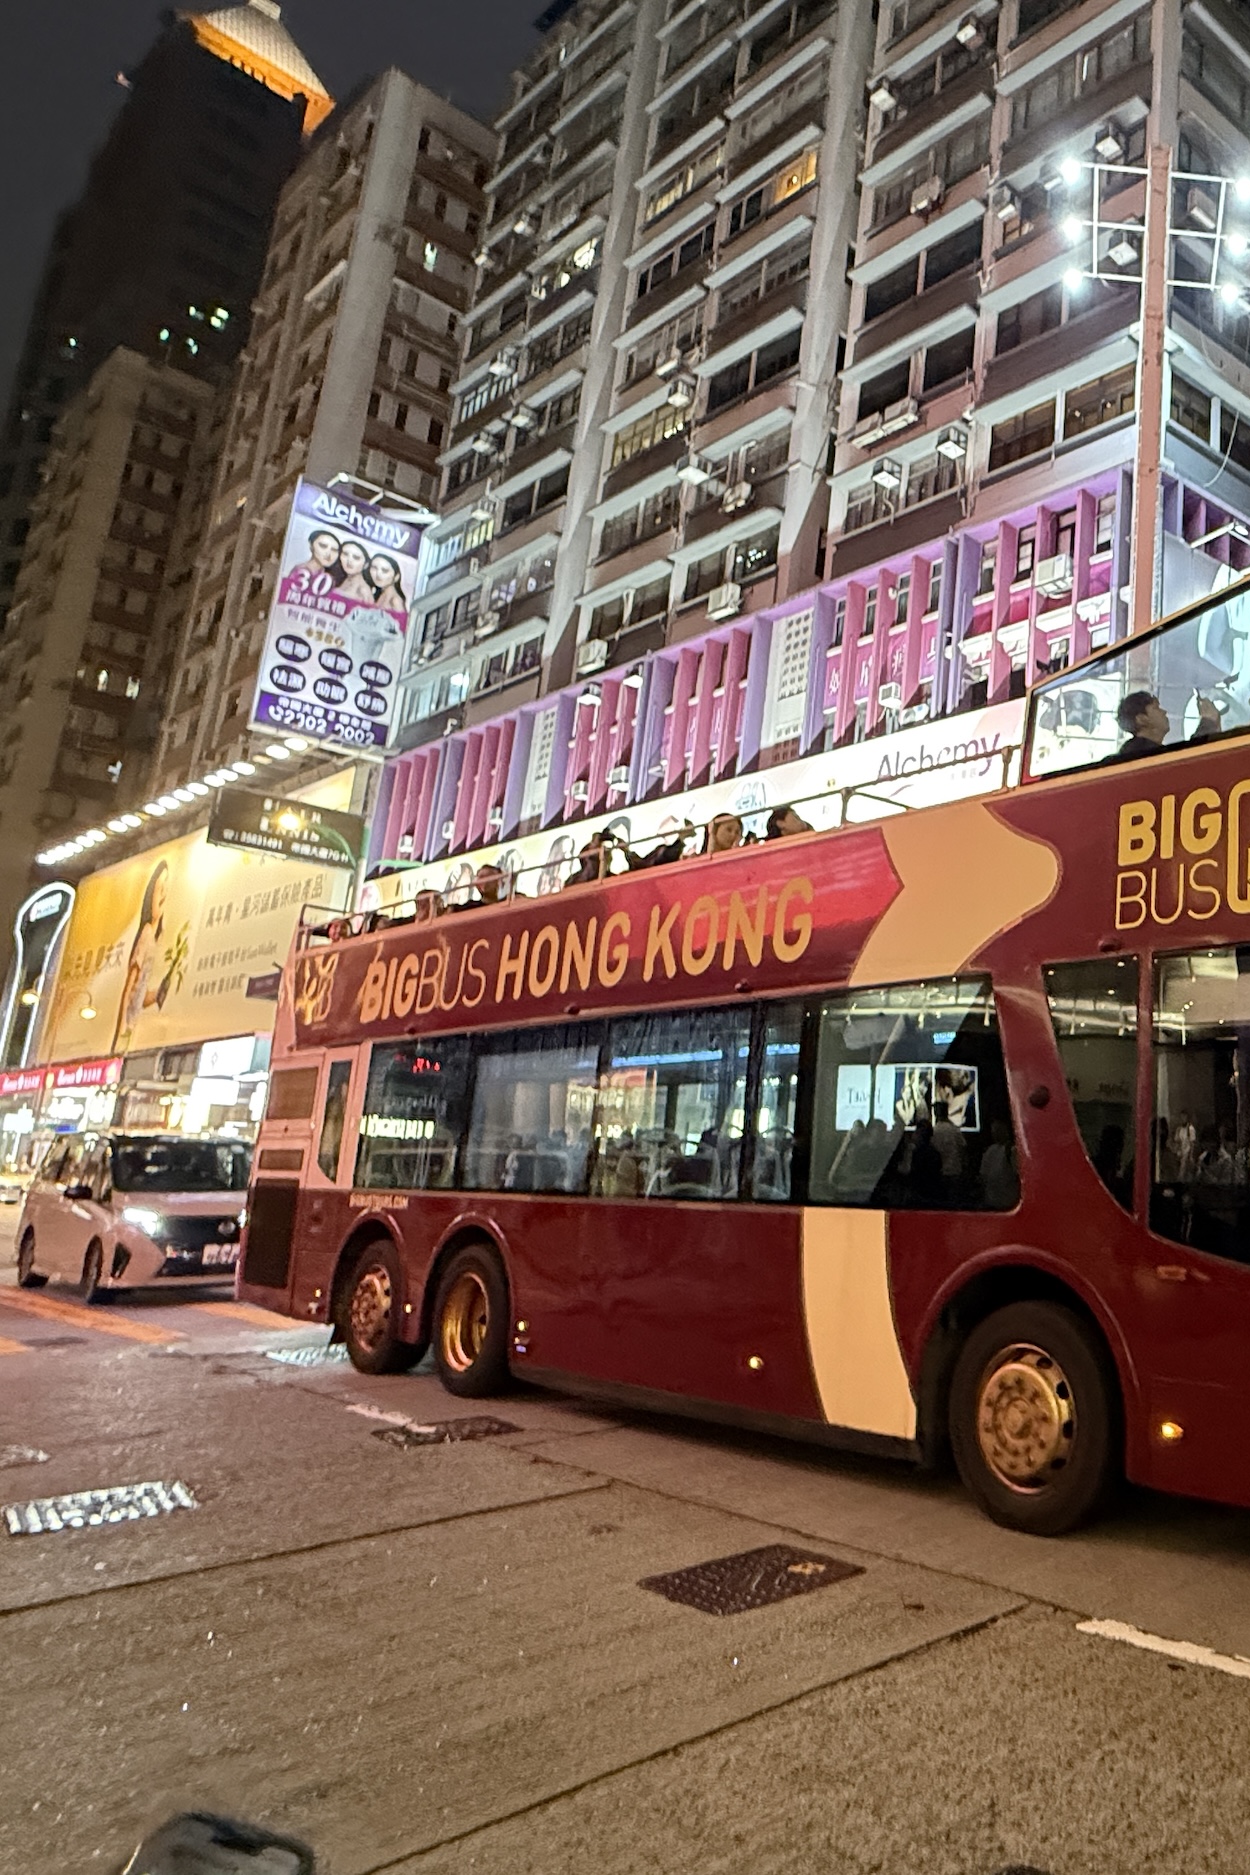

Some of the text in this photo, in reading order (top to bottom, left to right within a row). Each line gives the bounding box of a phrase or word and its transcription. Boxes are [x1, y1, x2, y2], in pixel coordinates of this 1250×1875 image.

[312, 492, 411, 549] Alchemy
[1118, 787, 1222, 867] BIG
[1115, 858, 1221, 930] BUS
[496, 910, 632, 1004] HONG
[642, 876, 815, 983] KONG
